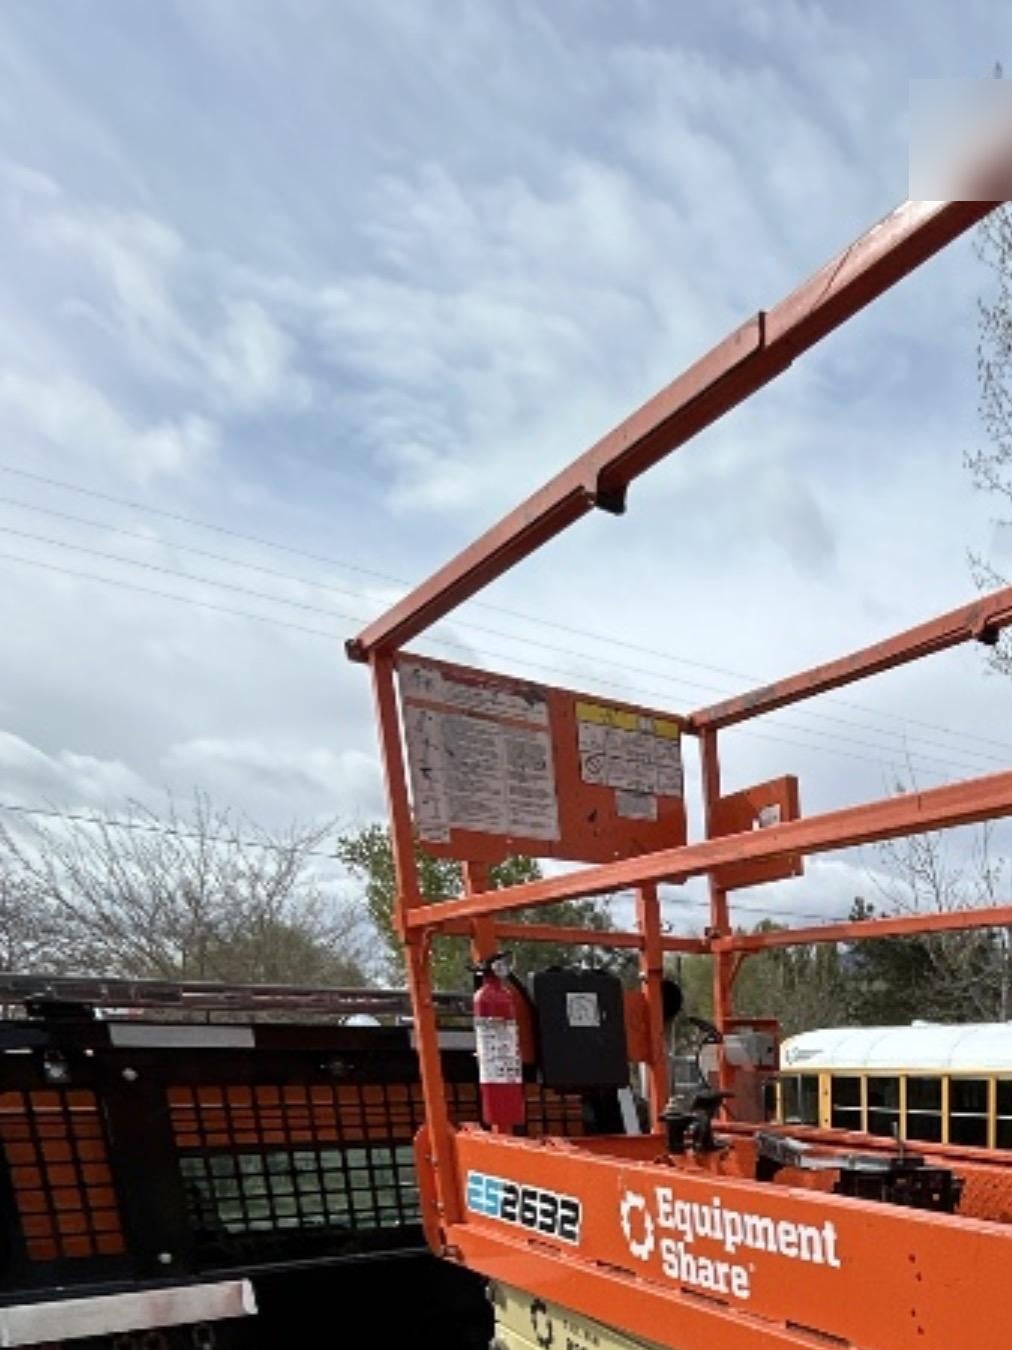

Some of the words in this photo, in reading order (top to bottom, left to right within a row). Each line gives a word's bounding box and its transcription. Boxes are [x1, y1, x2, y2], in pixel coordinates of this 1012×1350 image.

[466, 1171, 582, 1245] ES2632
[655, 1186, 841, 1268] Equipment
[660, 1237, 751, 1300] Share
